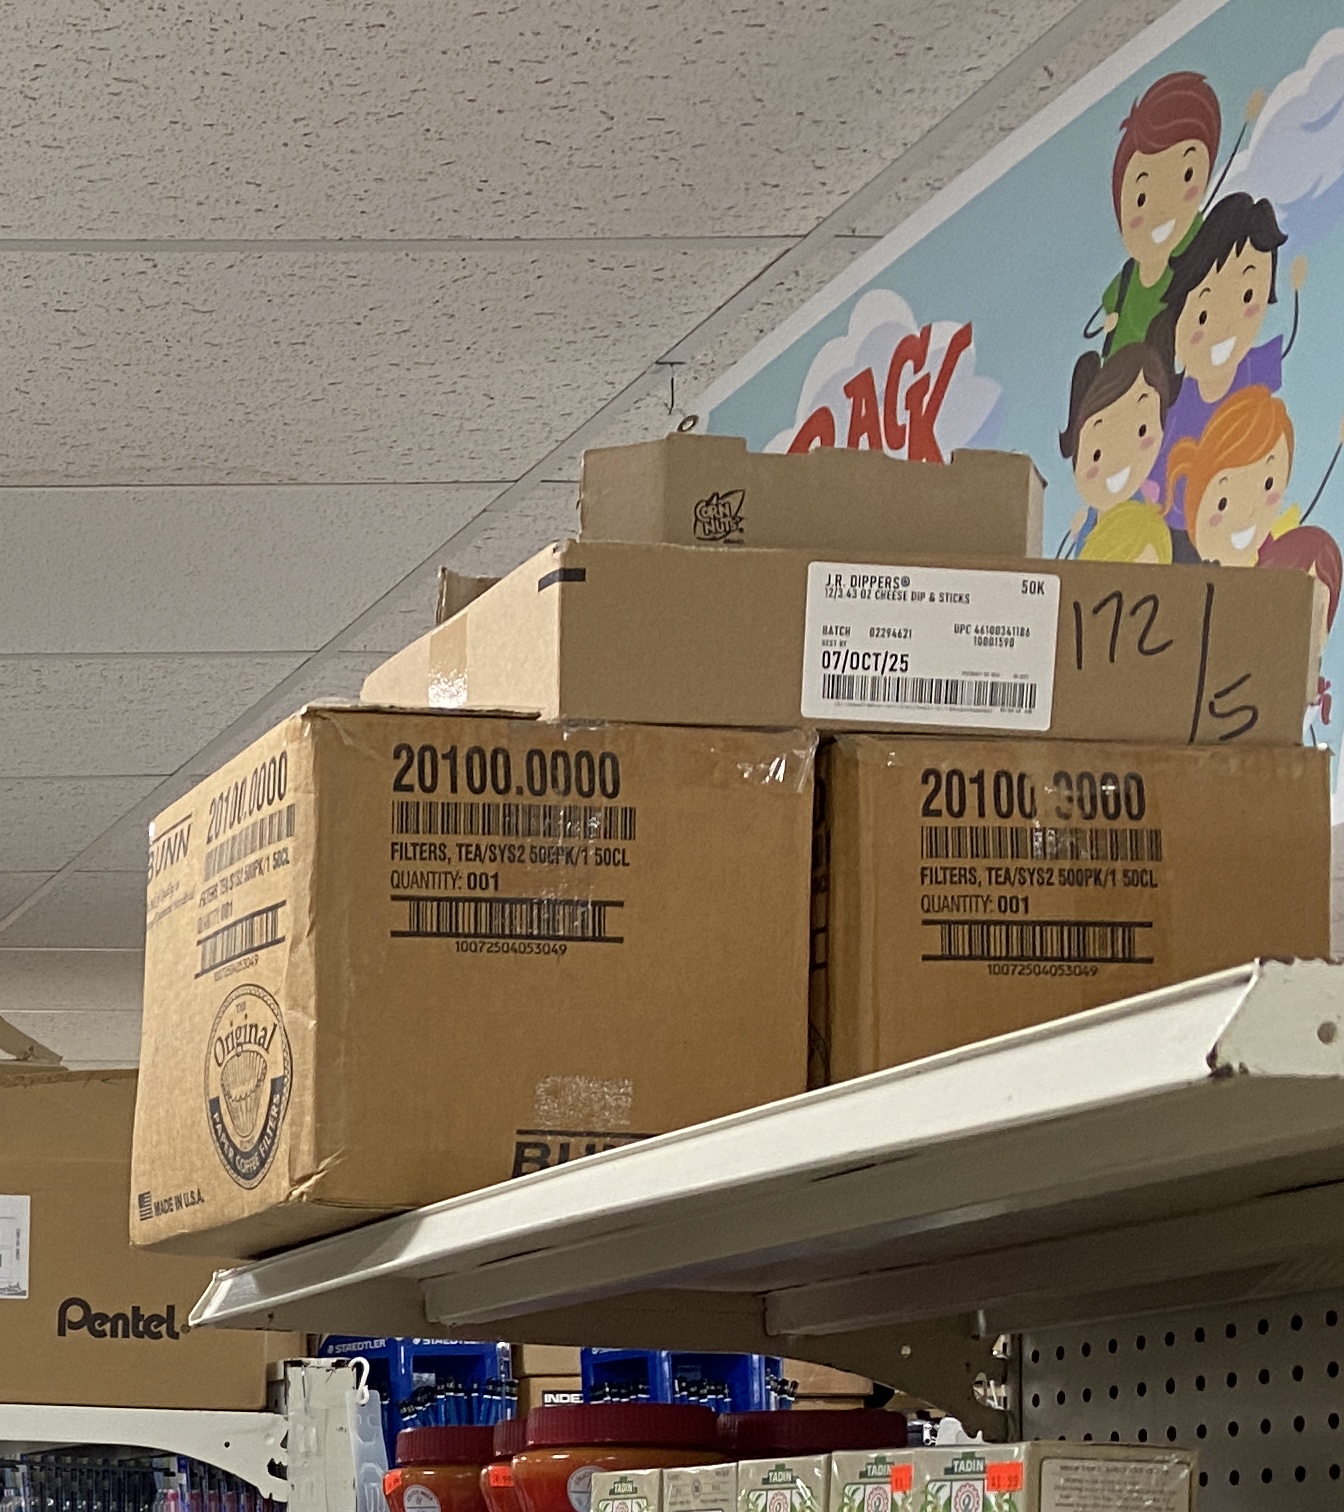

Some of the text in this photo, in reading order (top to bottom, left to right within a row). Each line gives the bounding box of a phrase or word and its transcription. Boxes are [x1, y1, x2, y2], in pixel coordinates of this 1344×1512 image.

[696, 500, 733, 521] CORN
[702, 518, 740, 537] NUTS
[825, 574, 846, 588] J.R.
[1021, 579, 1045, 596] 50K
[874, 590, 907, 601] CHEESE
[911, 591, 926, 602] DIP
[939, 592, 971, 604] STICKS
[822, 625, 851, 637] BATCH
[953, 624, 972, 635] UPC
[822, 648, 909, 675] 07/OCT/25
[393, 743, 620, 799] 20100.0000
[206, 750, 288, 845] 20100.0000
[390, 842, 451, 865] FILTERS,
[456, 842, 526, 864] TEA/SYS2
[595, 848, 630, 867] 50CL
[390, 870, 499, 891] QUANTITY: 001
[920, 866, 1159, 888] FILTERS, TEA/SYS2 500PK/1 50CL
[920, 895, 1029, 914] QUANTITY: 001
[455, 940, 567, 955] 10072504053049
[987, 963, 1098, 977] 10072504053049
[214, 1014, 277, 1067] Original
[259, 1094, 281, 1157] FILTERS
[153, 1198, 173, 1216] MADE
[57, 1297, 180, 1340] Pentel
[335, 1339, 386, 1353] STAEDTLER
[953, 1459, 984, 1473] TADIN
[768, 1471, 793, 1482] TADIN
[614, 1483, 634, 1493] TADIN
